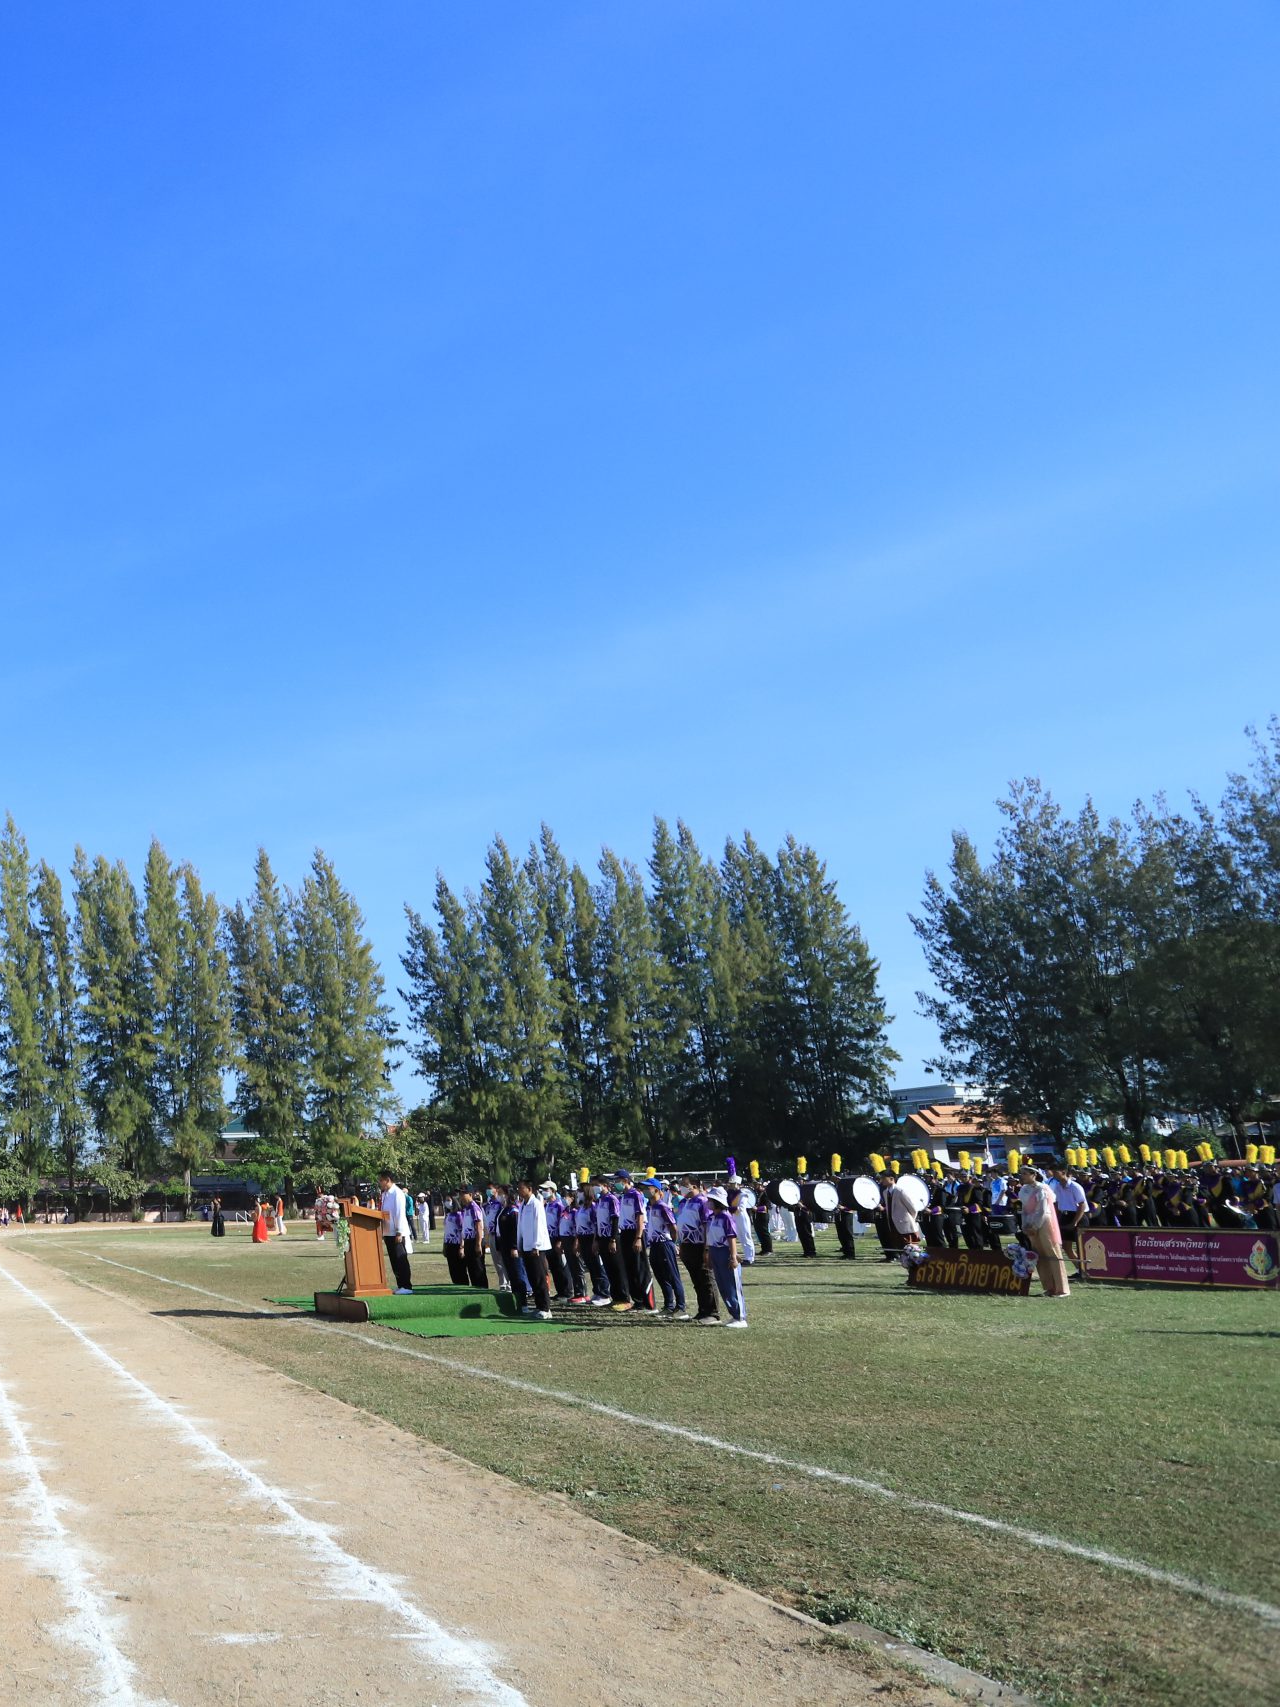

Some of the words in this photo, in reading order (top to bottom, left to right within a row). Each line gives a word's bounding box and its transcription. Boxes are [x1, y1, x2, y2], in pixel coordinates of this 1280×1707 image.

[1134, 1235, 1220, 1250] โรงเรียนสรรพวิทยาคม
[915, 1253, 1022, 1291] สรรพวิทยาคม
